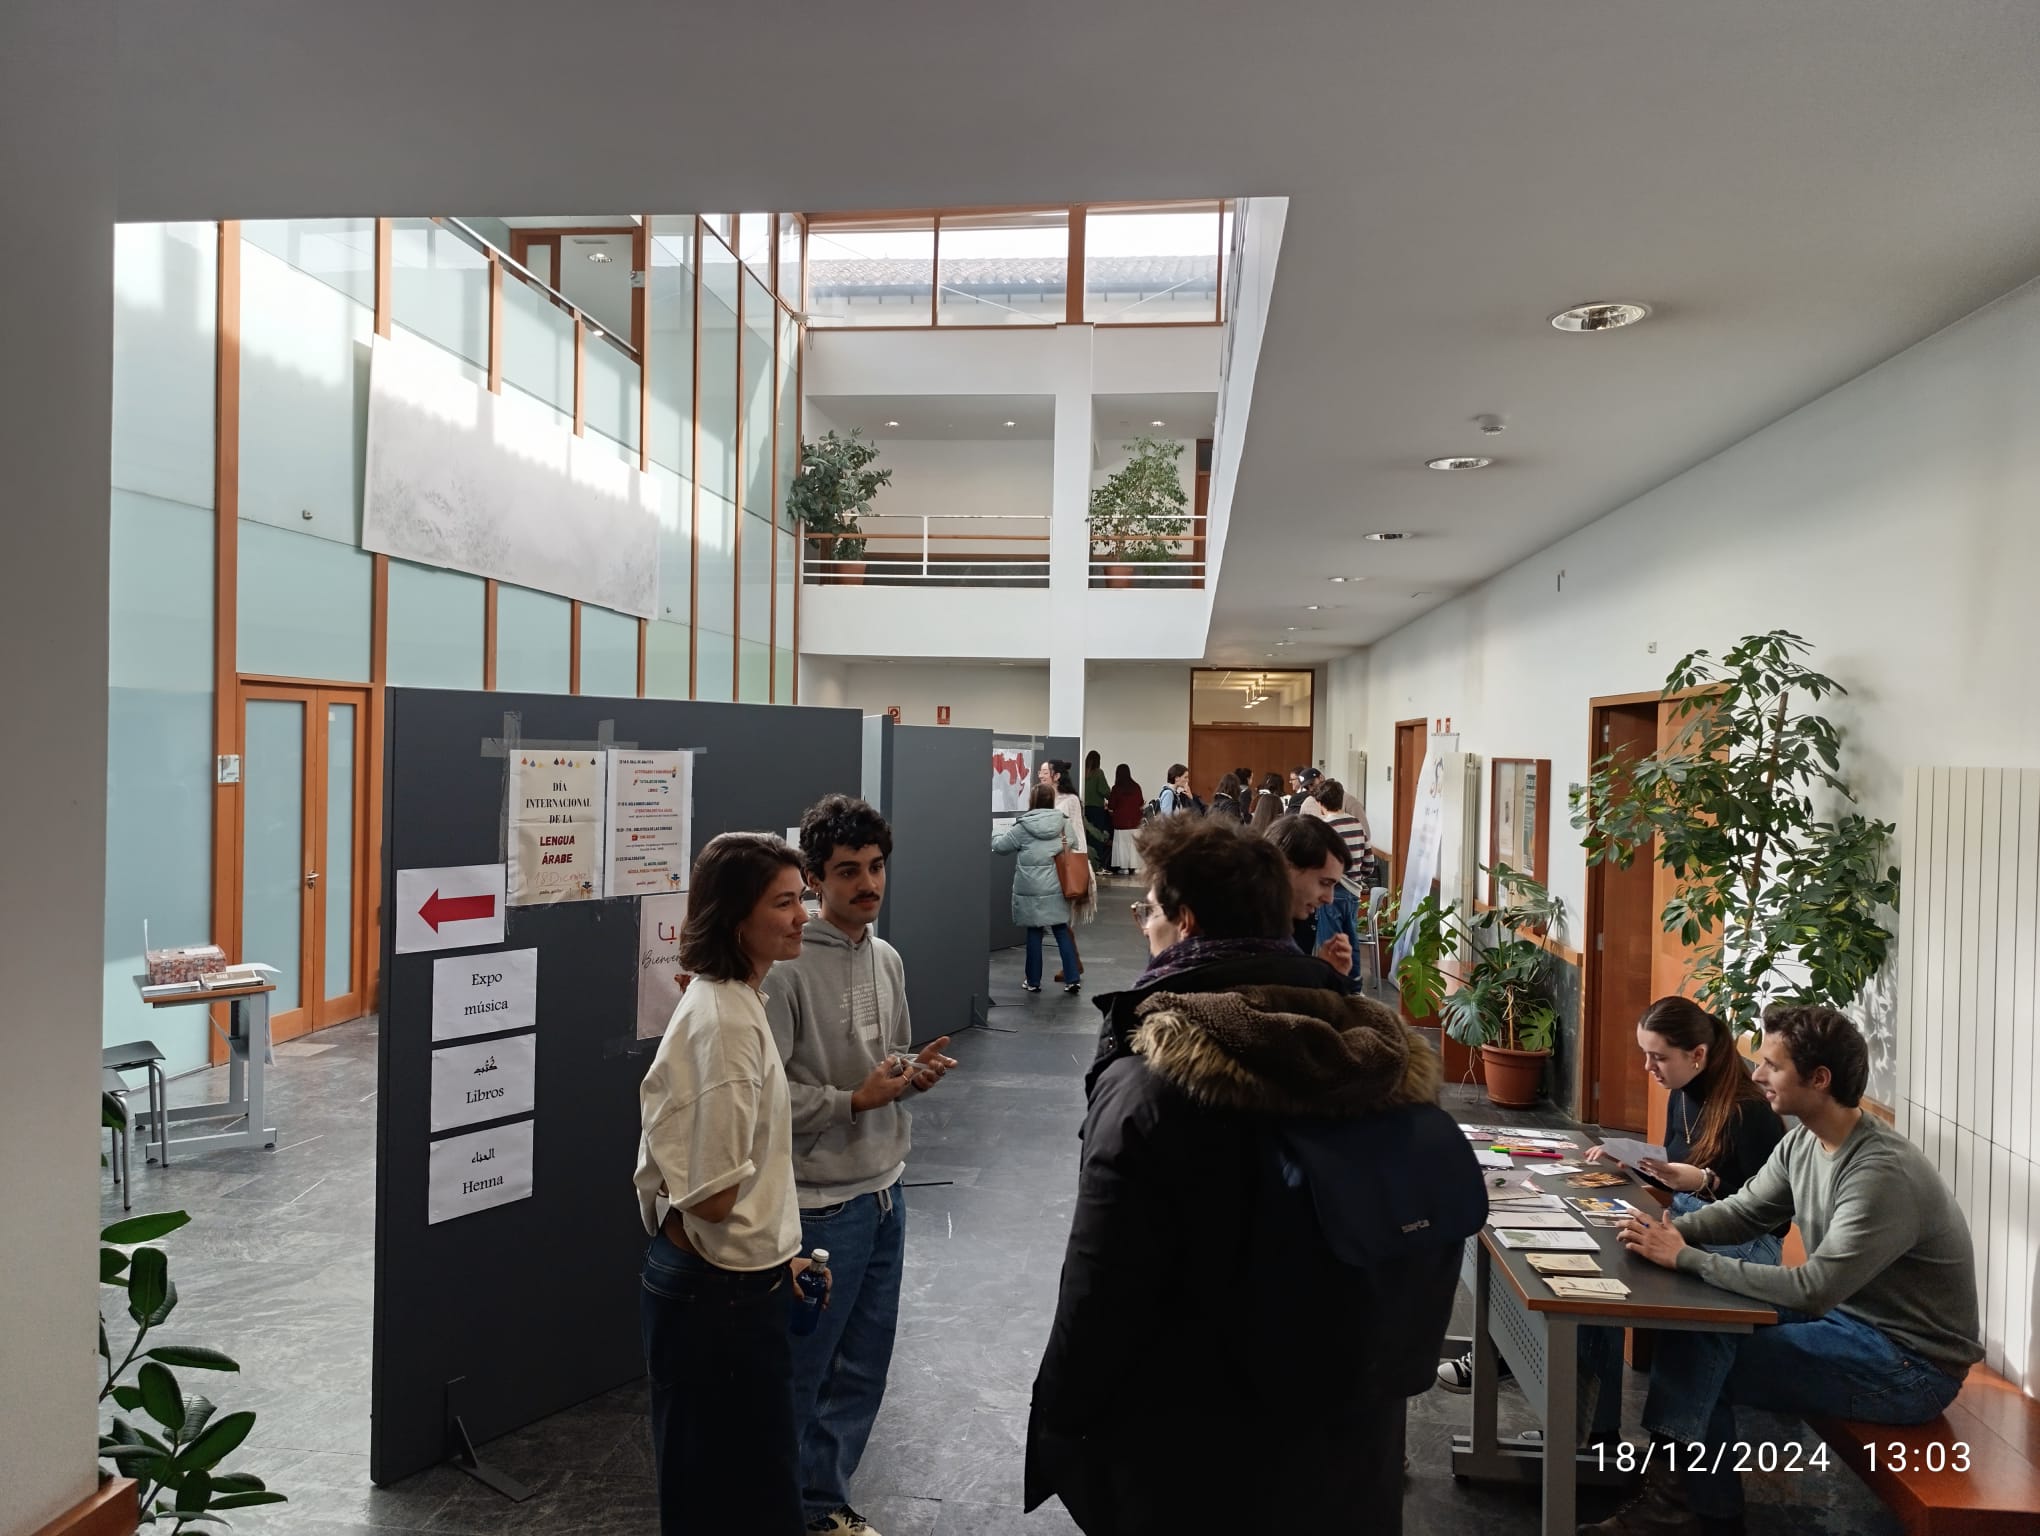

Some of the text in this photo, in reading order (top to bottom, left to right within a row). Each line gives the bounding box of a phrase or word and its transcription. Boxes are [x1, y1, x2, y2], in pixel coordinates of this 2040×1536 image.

[553, 780, 567, 792] DÍA
[526, 798, 592, 809] INTERNACIONAL
[550, 815, 573, 825] DE LA
[540, 835, 575, 847] LENGUA
[542, 852, 573, 865] ÁRABE
[472, 973, 502, 987] Expo
[464, 999, 508, 1015] música
[466, 1087, 504, 1103] Libros
[462, 1175, 505, 1195] Henna
